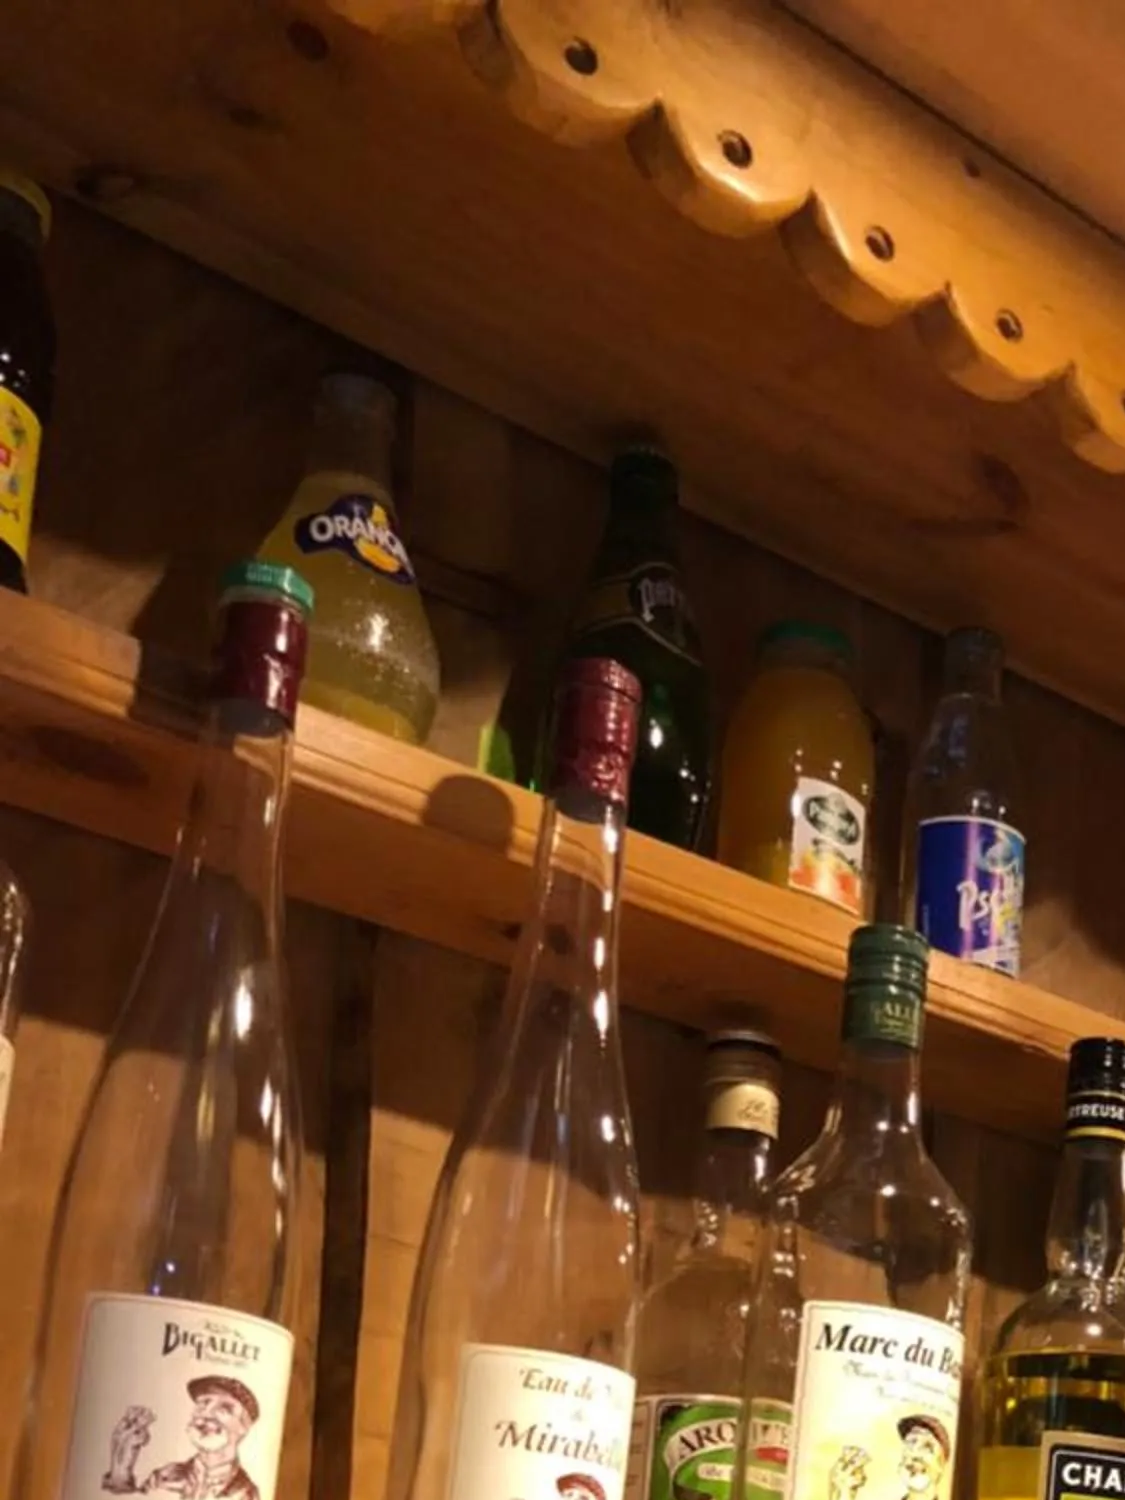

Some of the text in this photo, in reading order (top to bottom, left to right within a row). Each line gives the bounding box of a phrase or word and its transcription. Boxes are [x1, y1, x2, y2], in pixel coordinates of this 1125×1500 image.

[815, 1322, 898, 1360] Marc
[904, 1336, 934, 1368] du
[520, 1368, 569, 1394] Eau
